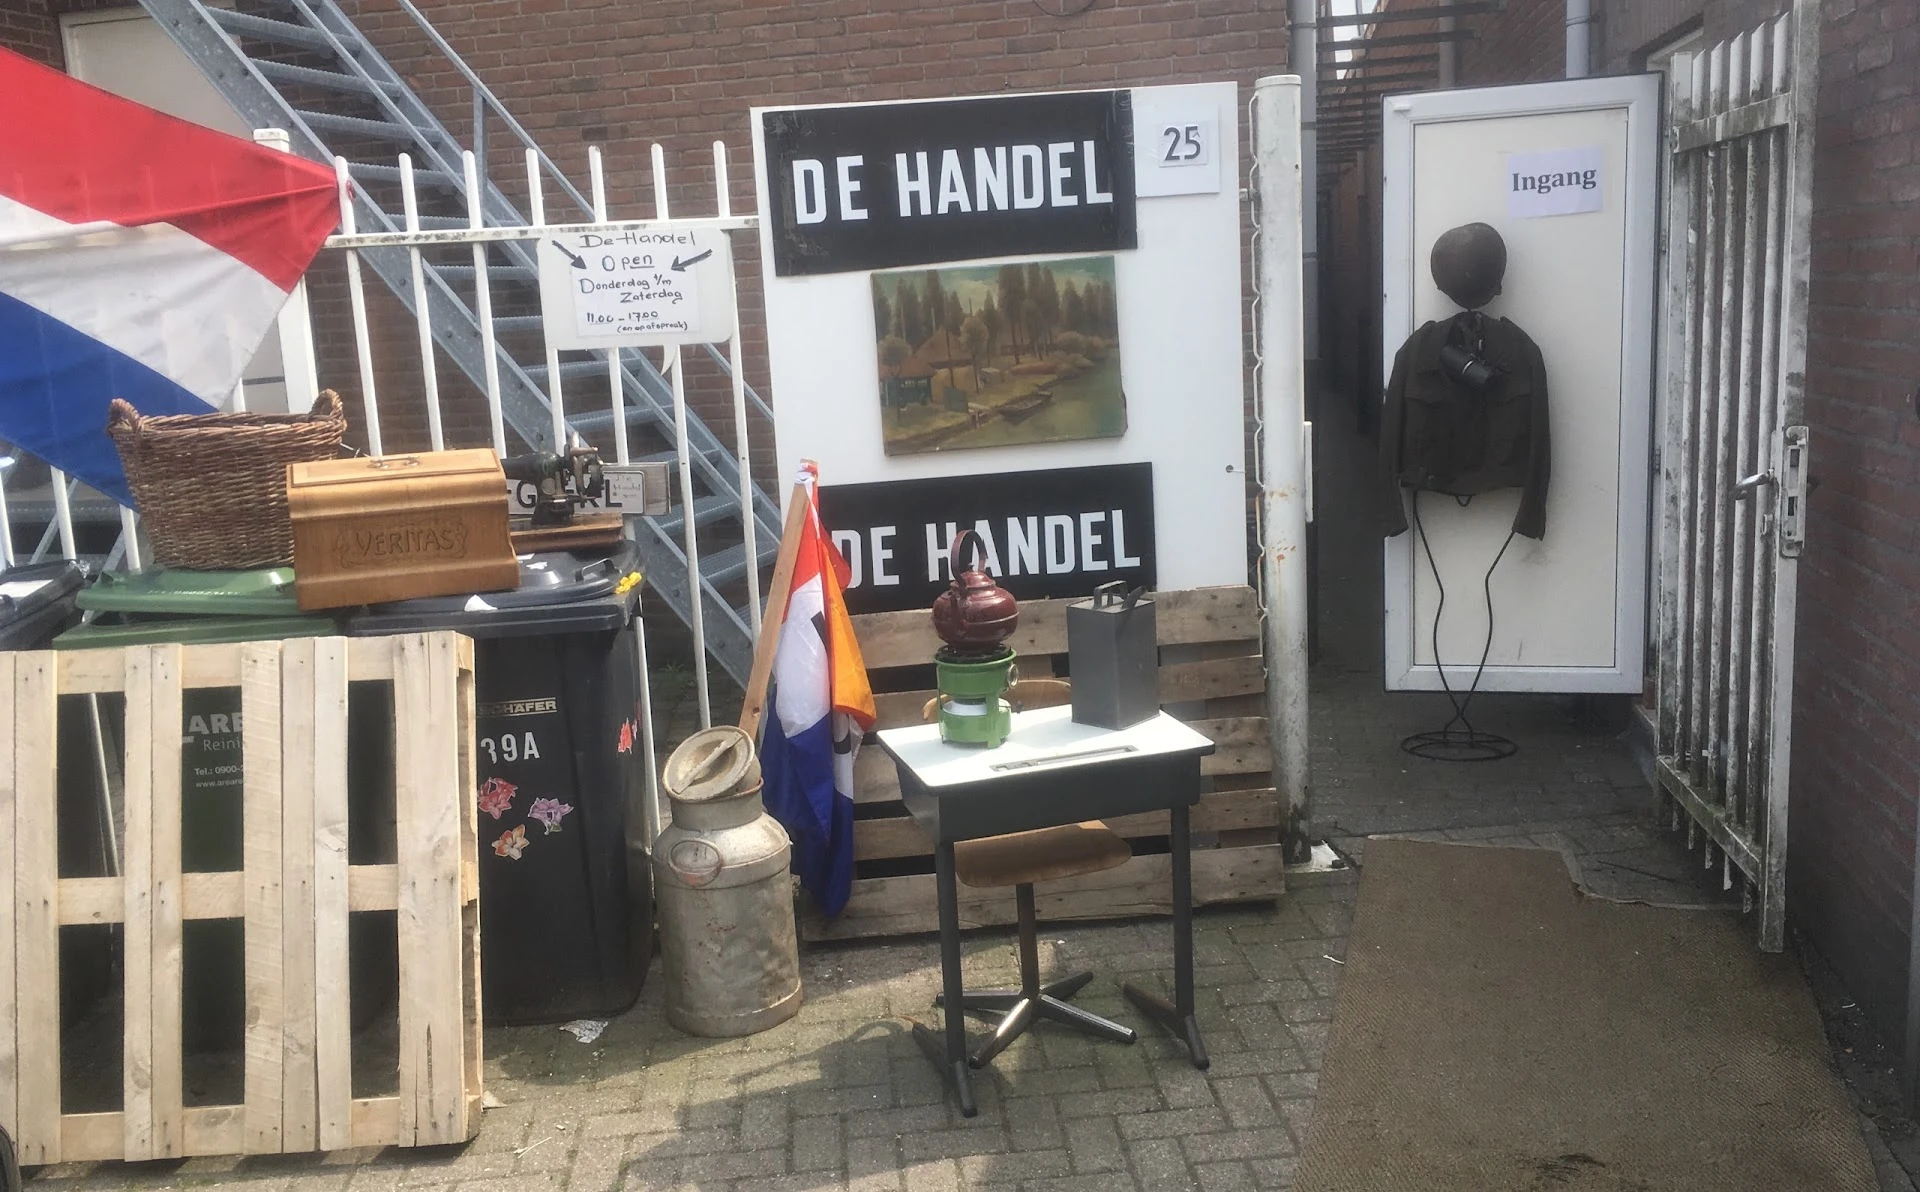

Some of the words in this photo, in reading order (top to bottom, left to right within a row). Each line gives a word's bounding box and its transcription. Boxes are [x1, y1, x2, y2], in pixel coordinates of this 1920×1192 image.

[1163, 125, 1201, 162] 25
[792, 155, 869, 225] DE
[895, 140, 1113, 218] HANDEL
[1512, 169, 1597, 194] Ingang
[579, 234, 614, 248] De
[615, 231, 695, 246] Handel
[602, 254, 655, 272] Open
[579, 278, 650, 294] Donderdag
[620, 288, 683, 304] Zaterdag
[587, 312, 614, 324] 11.00
[356, 529, 455, 556] VERITAS
[831, 525, 900, 589] DE
[926, 509, 1141, 583] HANDEL
[480, 700, 557, 716] HÄFER
[481, 732, 541, 764] 39A
